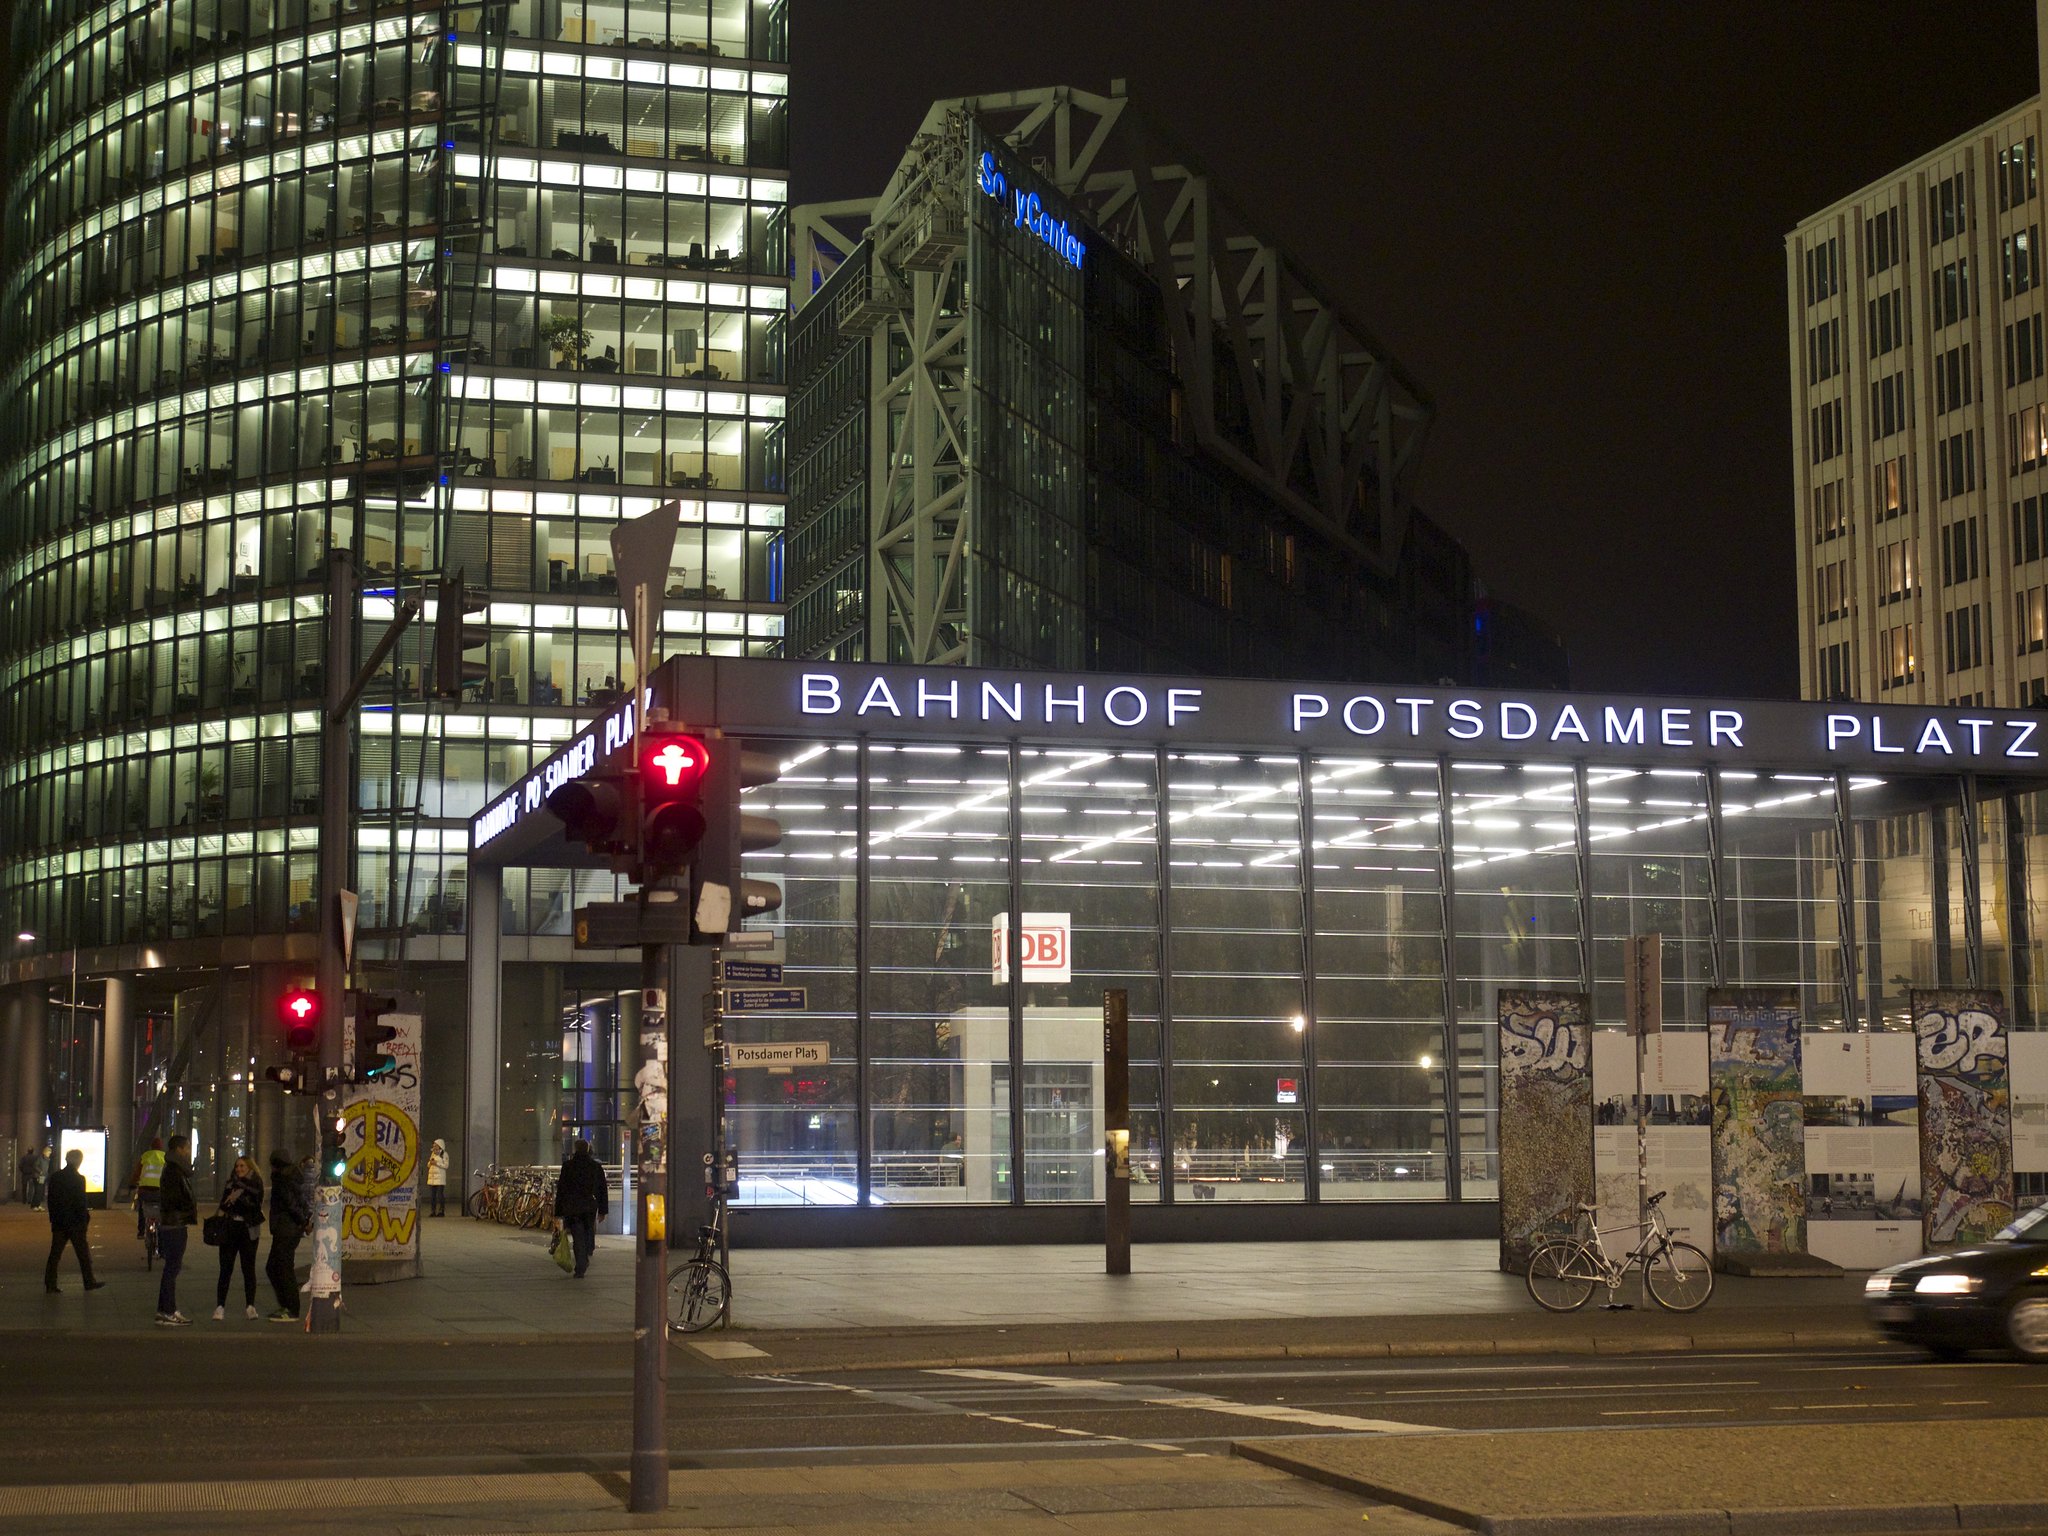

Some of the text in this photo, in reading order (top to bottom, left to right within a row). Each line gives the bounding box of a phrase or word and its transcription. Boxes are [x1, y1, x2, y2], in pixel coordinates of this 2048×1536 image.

[981, 151, 1087, 269] SoyCenter
[800, 672, 2039, 758] BAHNHOF POTSDAMER PLATZ
[1022, 933, 1058, 961] DB
[737, 1047, 818, 1060] Potsdamer Platz
